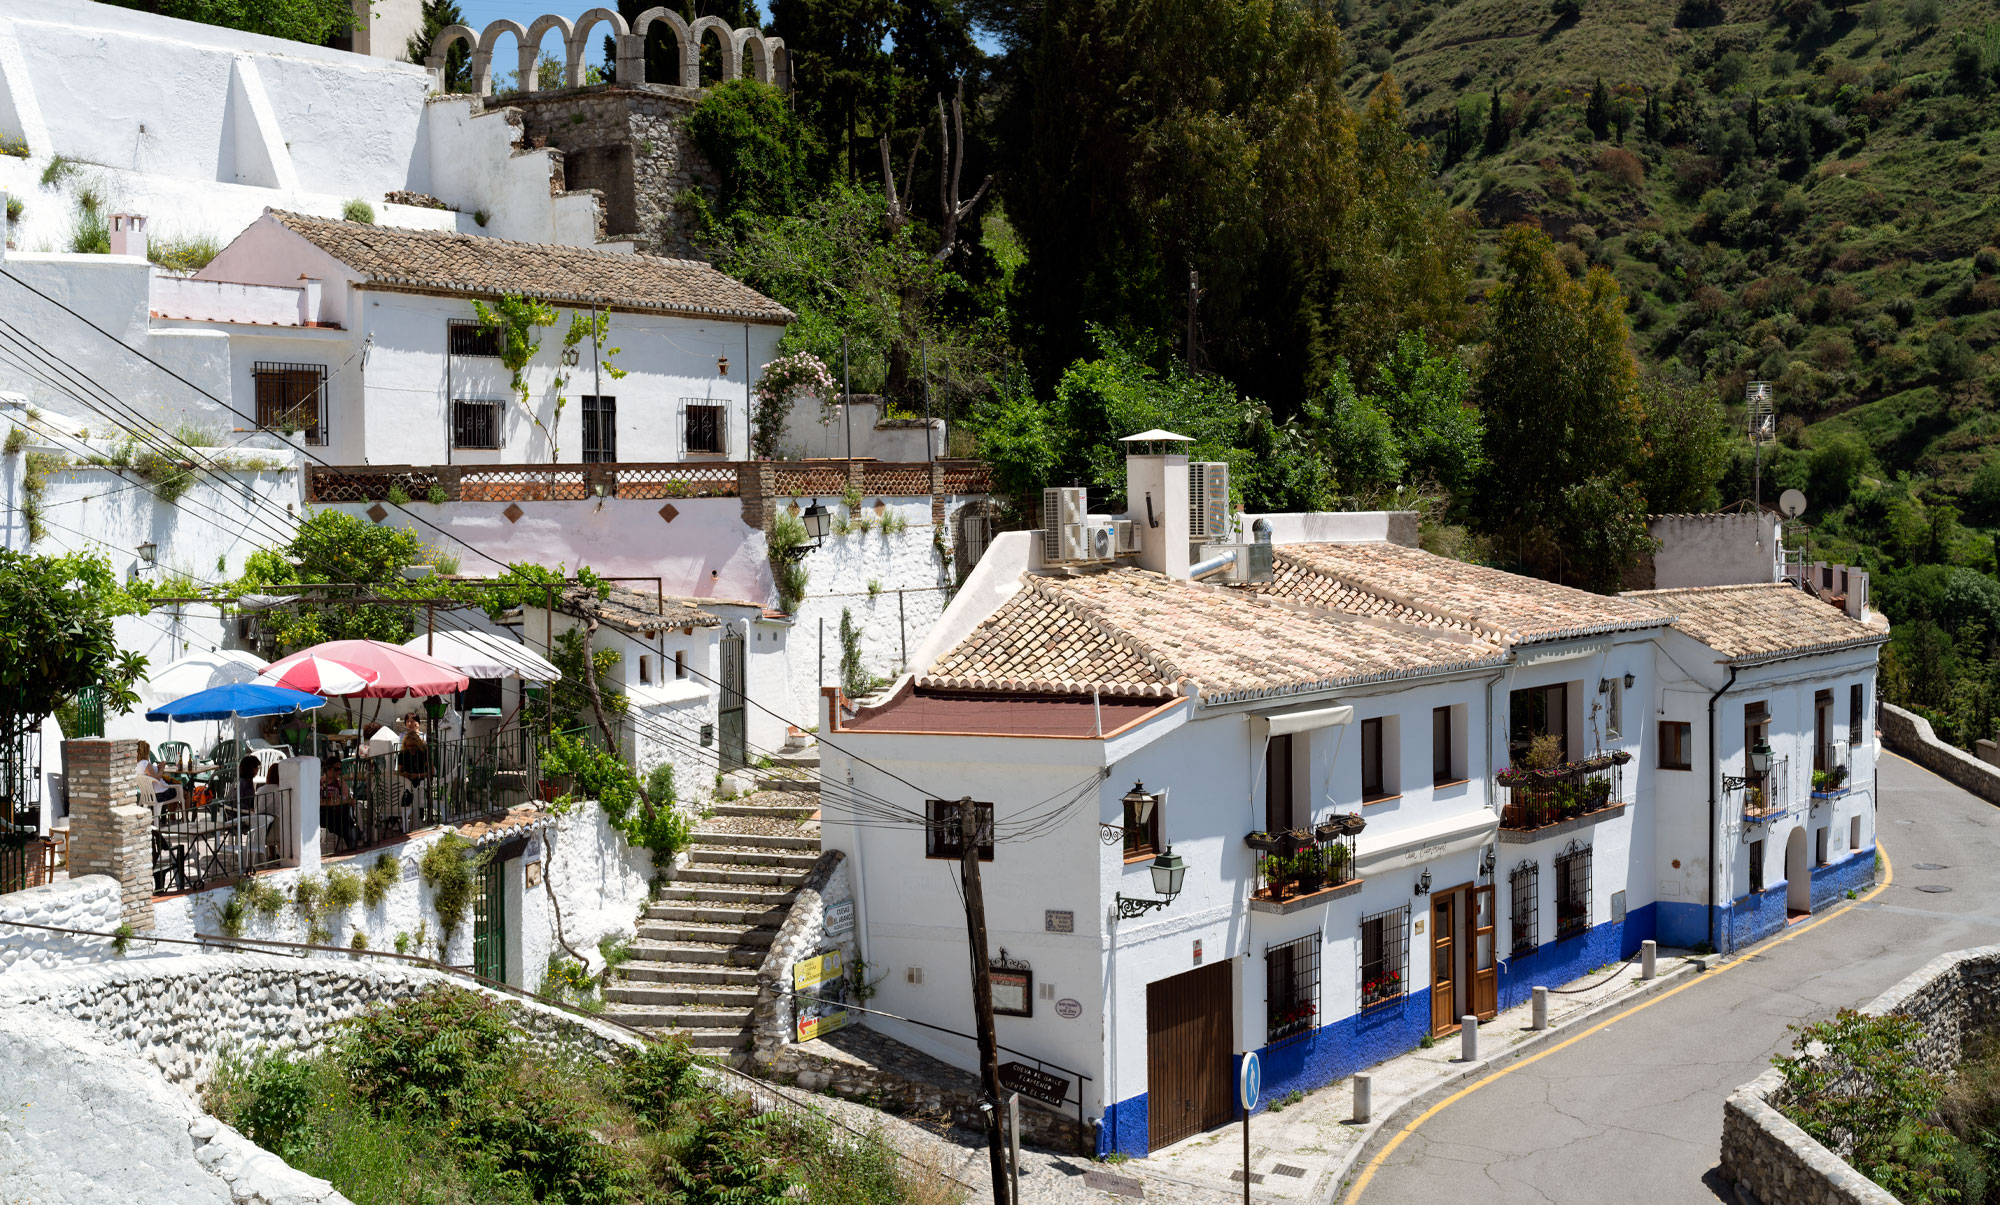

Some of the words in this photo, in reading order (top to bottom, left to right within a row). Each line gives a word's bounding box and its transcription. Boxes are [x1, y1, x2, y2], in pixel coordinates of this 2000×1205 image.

[837, 906, 850, 915] CUEVAS
[1013, 1065, 1031, 1075] CUEVA
[1019, 1075, 1051, 1090] FLAMENCO
[1005, 1080, 1026, 1092] VENTA
[1029, 1089, 1038, 1097] EL
[1040, 1093, 1059, 1103] GALLO
